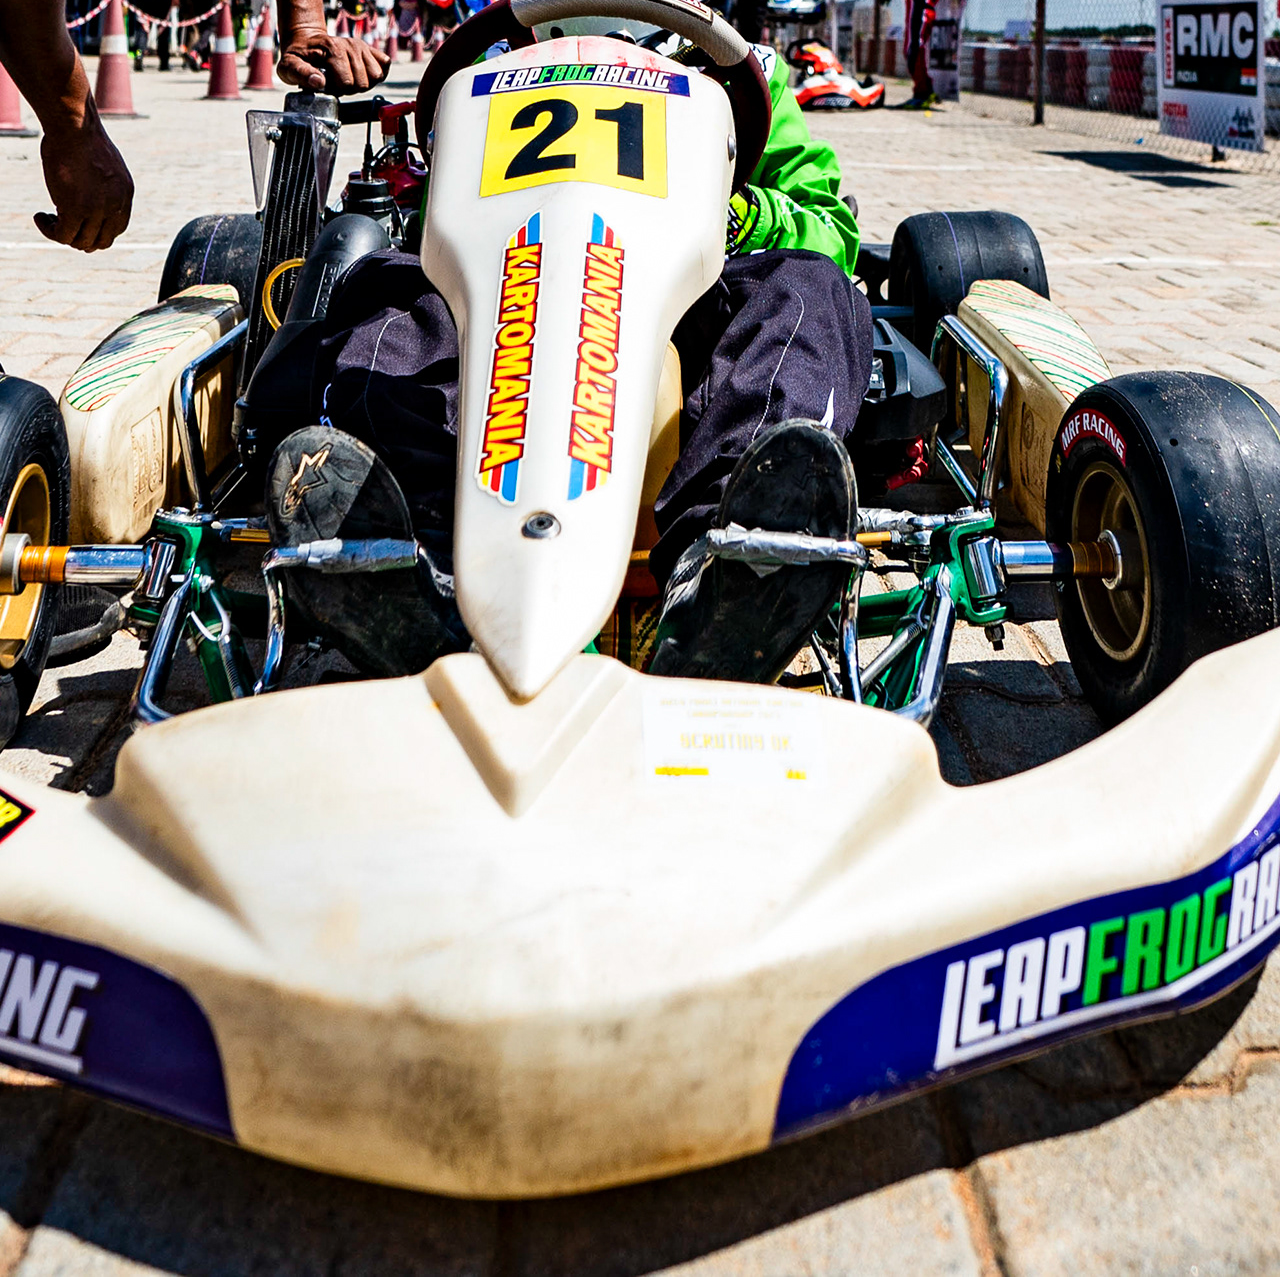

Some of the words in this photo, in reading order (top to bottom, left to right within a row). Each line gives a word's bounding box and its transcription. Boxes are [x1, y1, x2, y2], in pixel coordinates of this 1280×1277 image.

[1176, 10, 1255, 60] RMC
[1177, 70, 1198, 83] INDIA
[504, 98, 644, 180] 21
[479, 242, 542, 473] KARTOMANIA
[568, 242, 624, 473] KARTOMANIA
[1060, 414, 1081, 451] MRF
[1081, 412, 1125, 459] RACING
